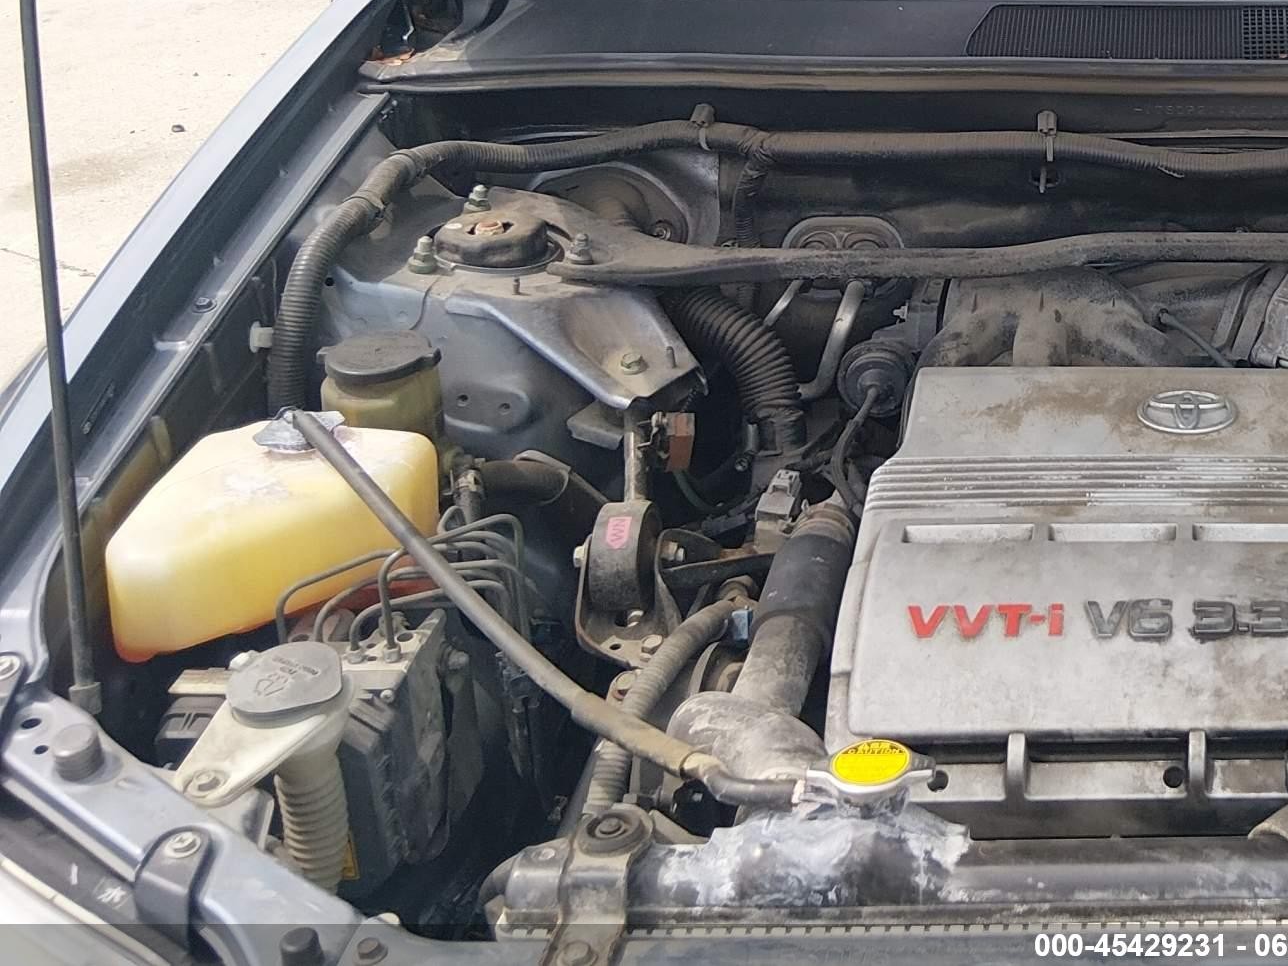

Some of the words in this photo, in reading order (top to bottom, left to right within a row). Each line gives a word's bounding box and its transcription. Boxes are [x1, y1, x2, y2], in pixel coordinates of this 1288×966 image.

[907, 603, 1065, 639] VVT-i
[1085, 598, 1174, 642] V6
[847, 747, 901, 755] CAUTION
